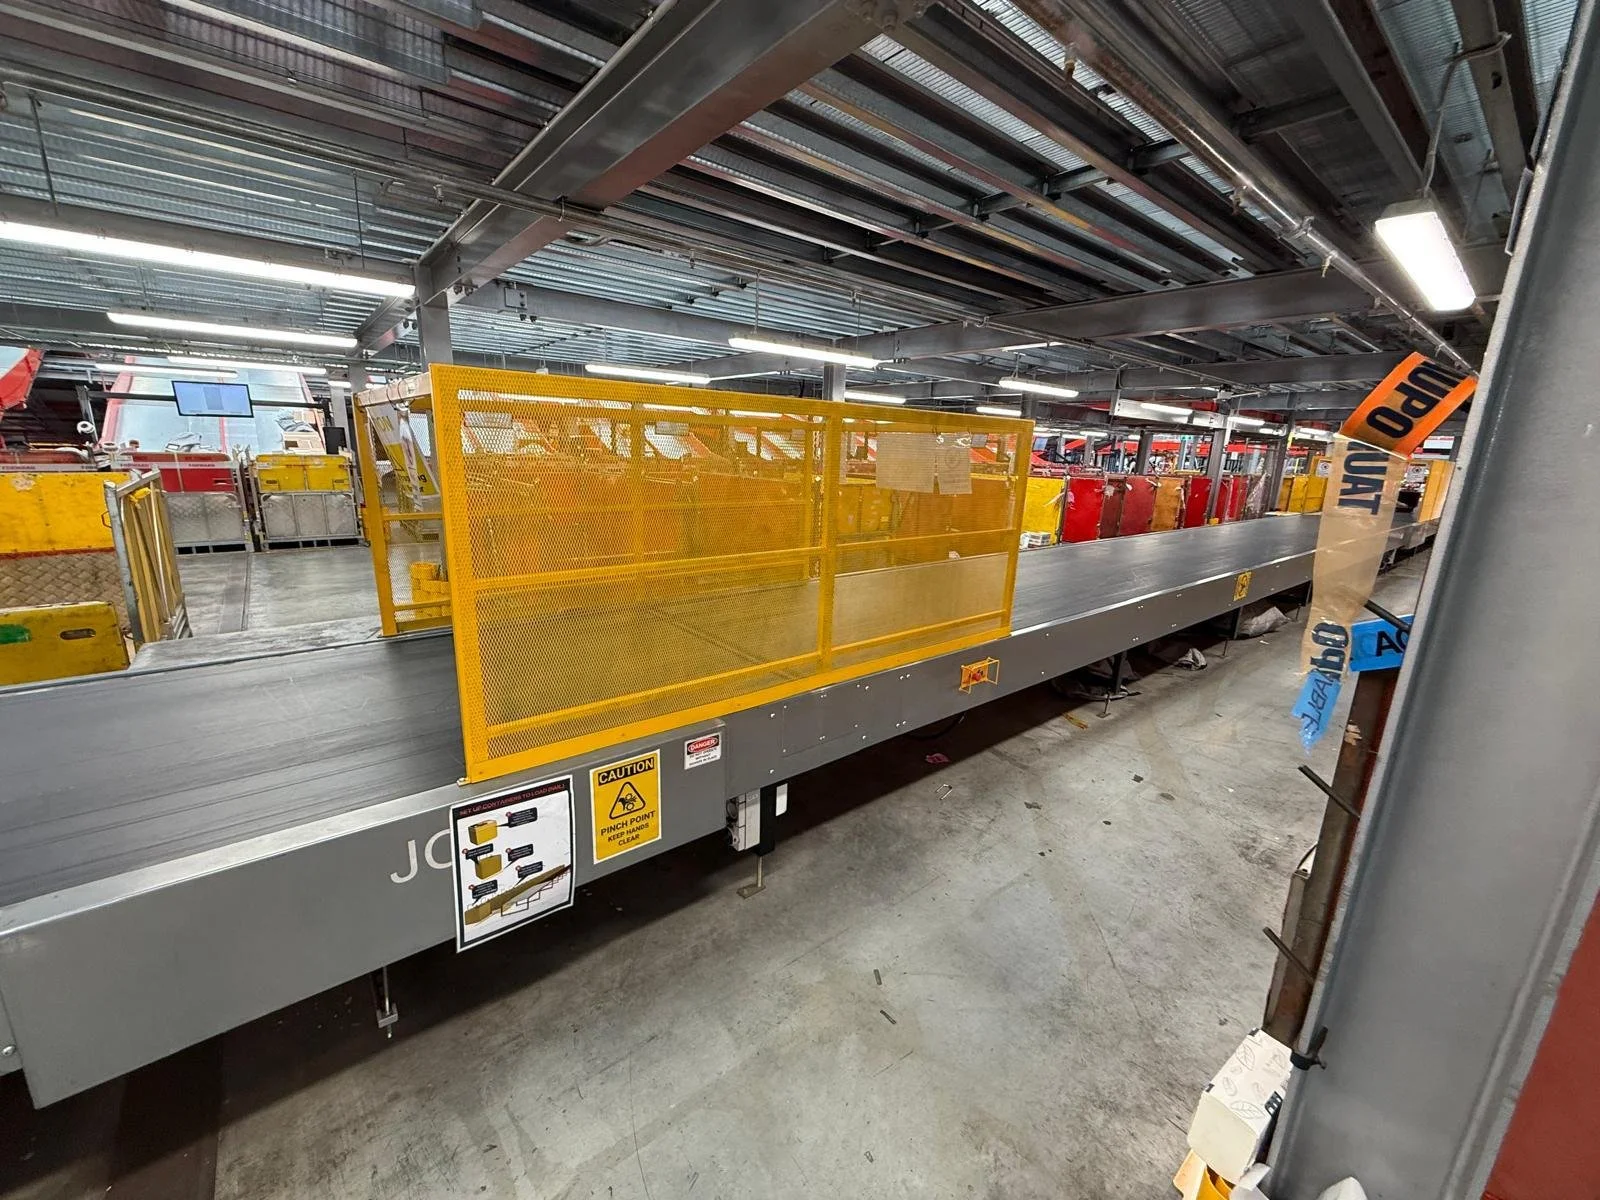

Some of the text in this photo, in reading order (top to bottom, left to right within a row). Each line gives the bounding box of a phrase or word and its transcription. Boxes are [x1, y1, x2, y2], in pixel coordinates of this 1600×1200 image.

[690, 739, 716, 751] DANGER
[599, 758, 655, 785] CAUTION
[472, 805, 482, 813] UP
[482, 795, 522, 810] CONTAINERS
[600, 810, 656, 836] PINCH POINT
[607, 822, 650, 843] KEEP HANDS
[618, 833, 640, 846] CLEAR
